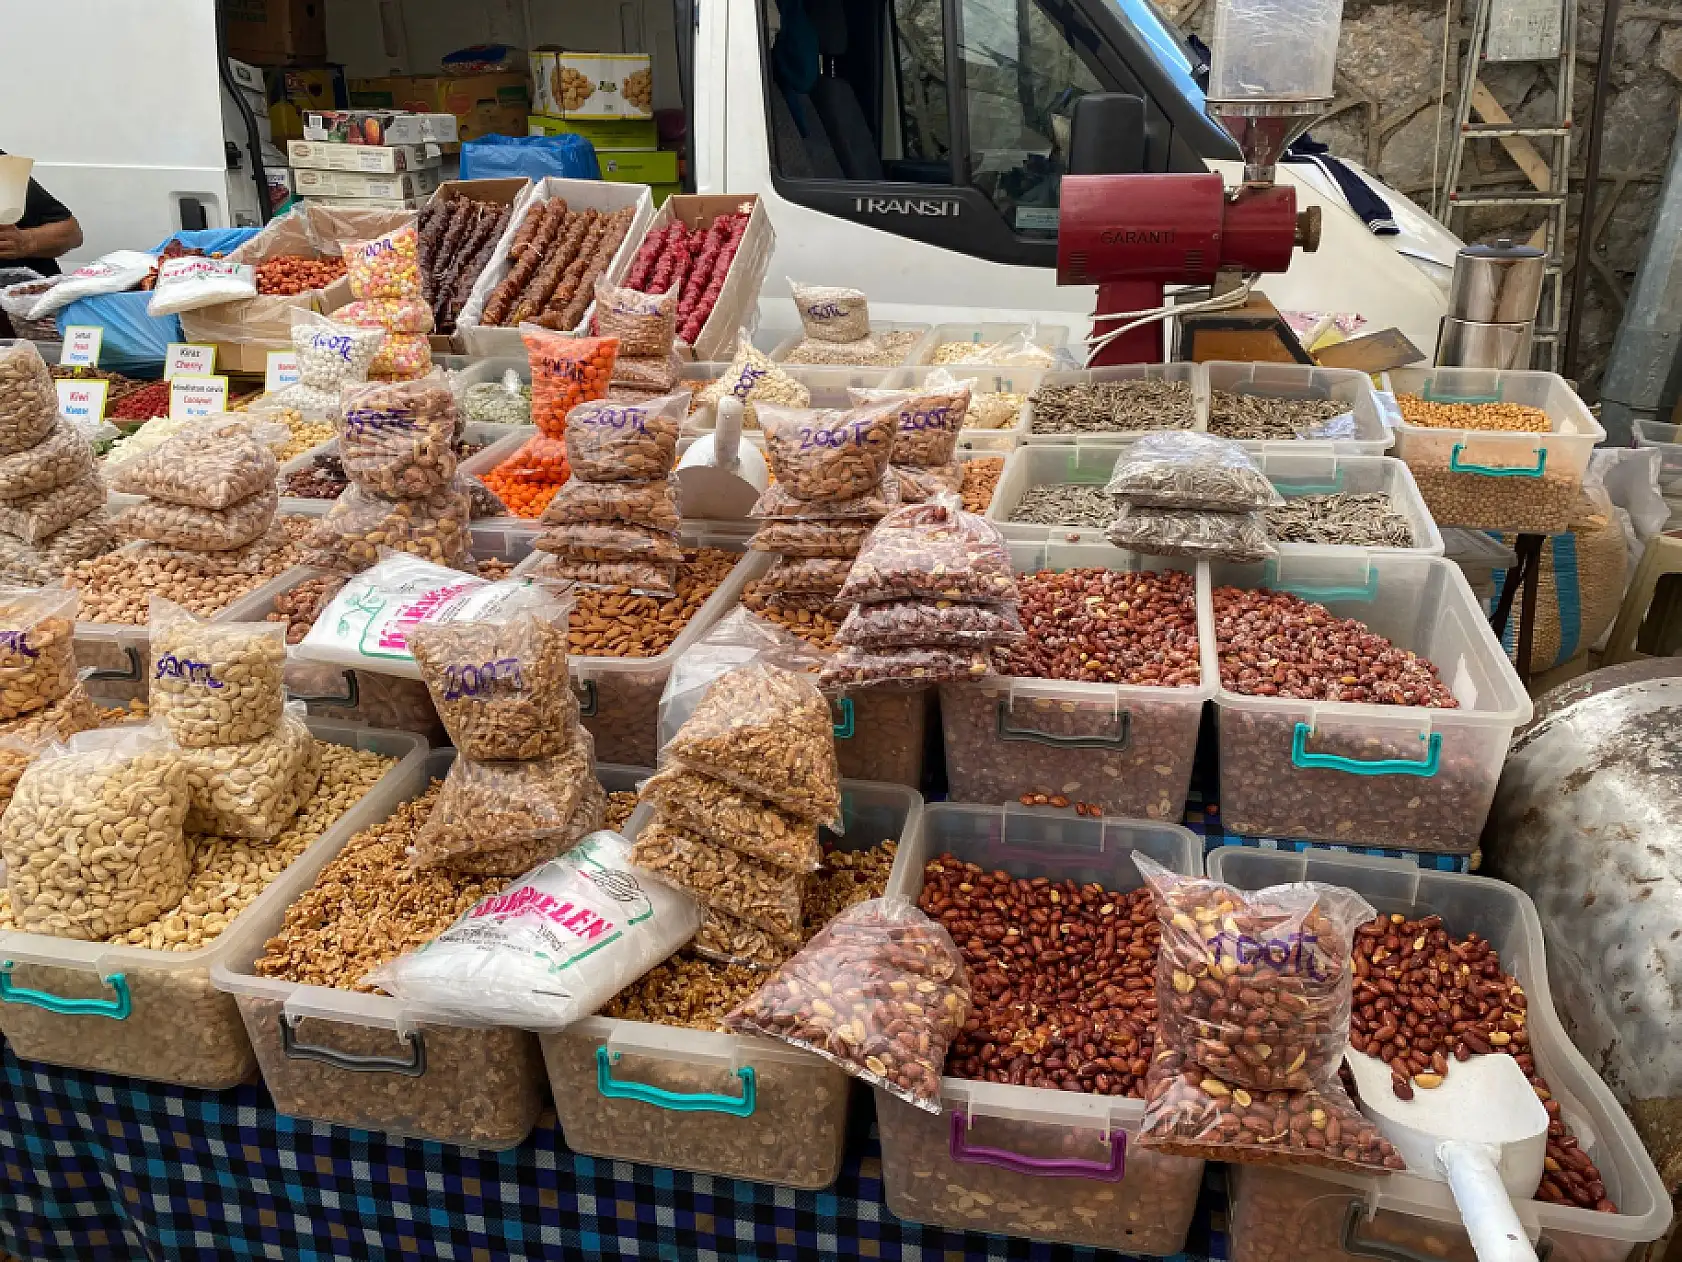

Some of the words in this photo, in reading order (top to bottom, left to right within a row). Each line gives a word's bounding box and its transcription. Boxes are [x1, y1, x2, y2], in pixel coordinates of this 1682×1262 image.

[853, 197, 960, 216] TRANSIT
[174, 361, 204, 372] Cherry
[69, 391, 90, 402] Kiwi
